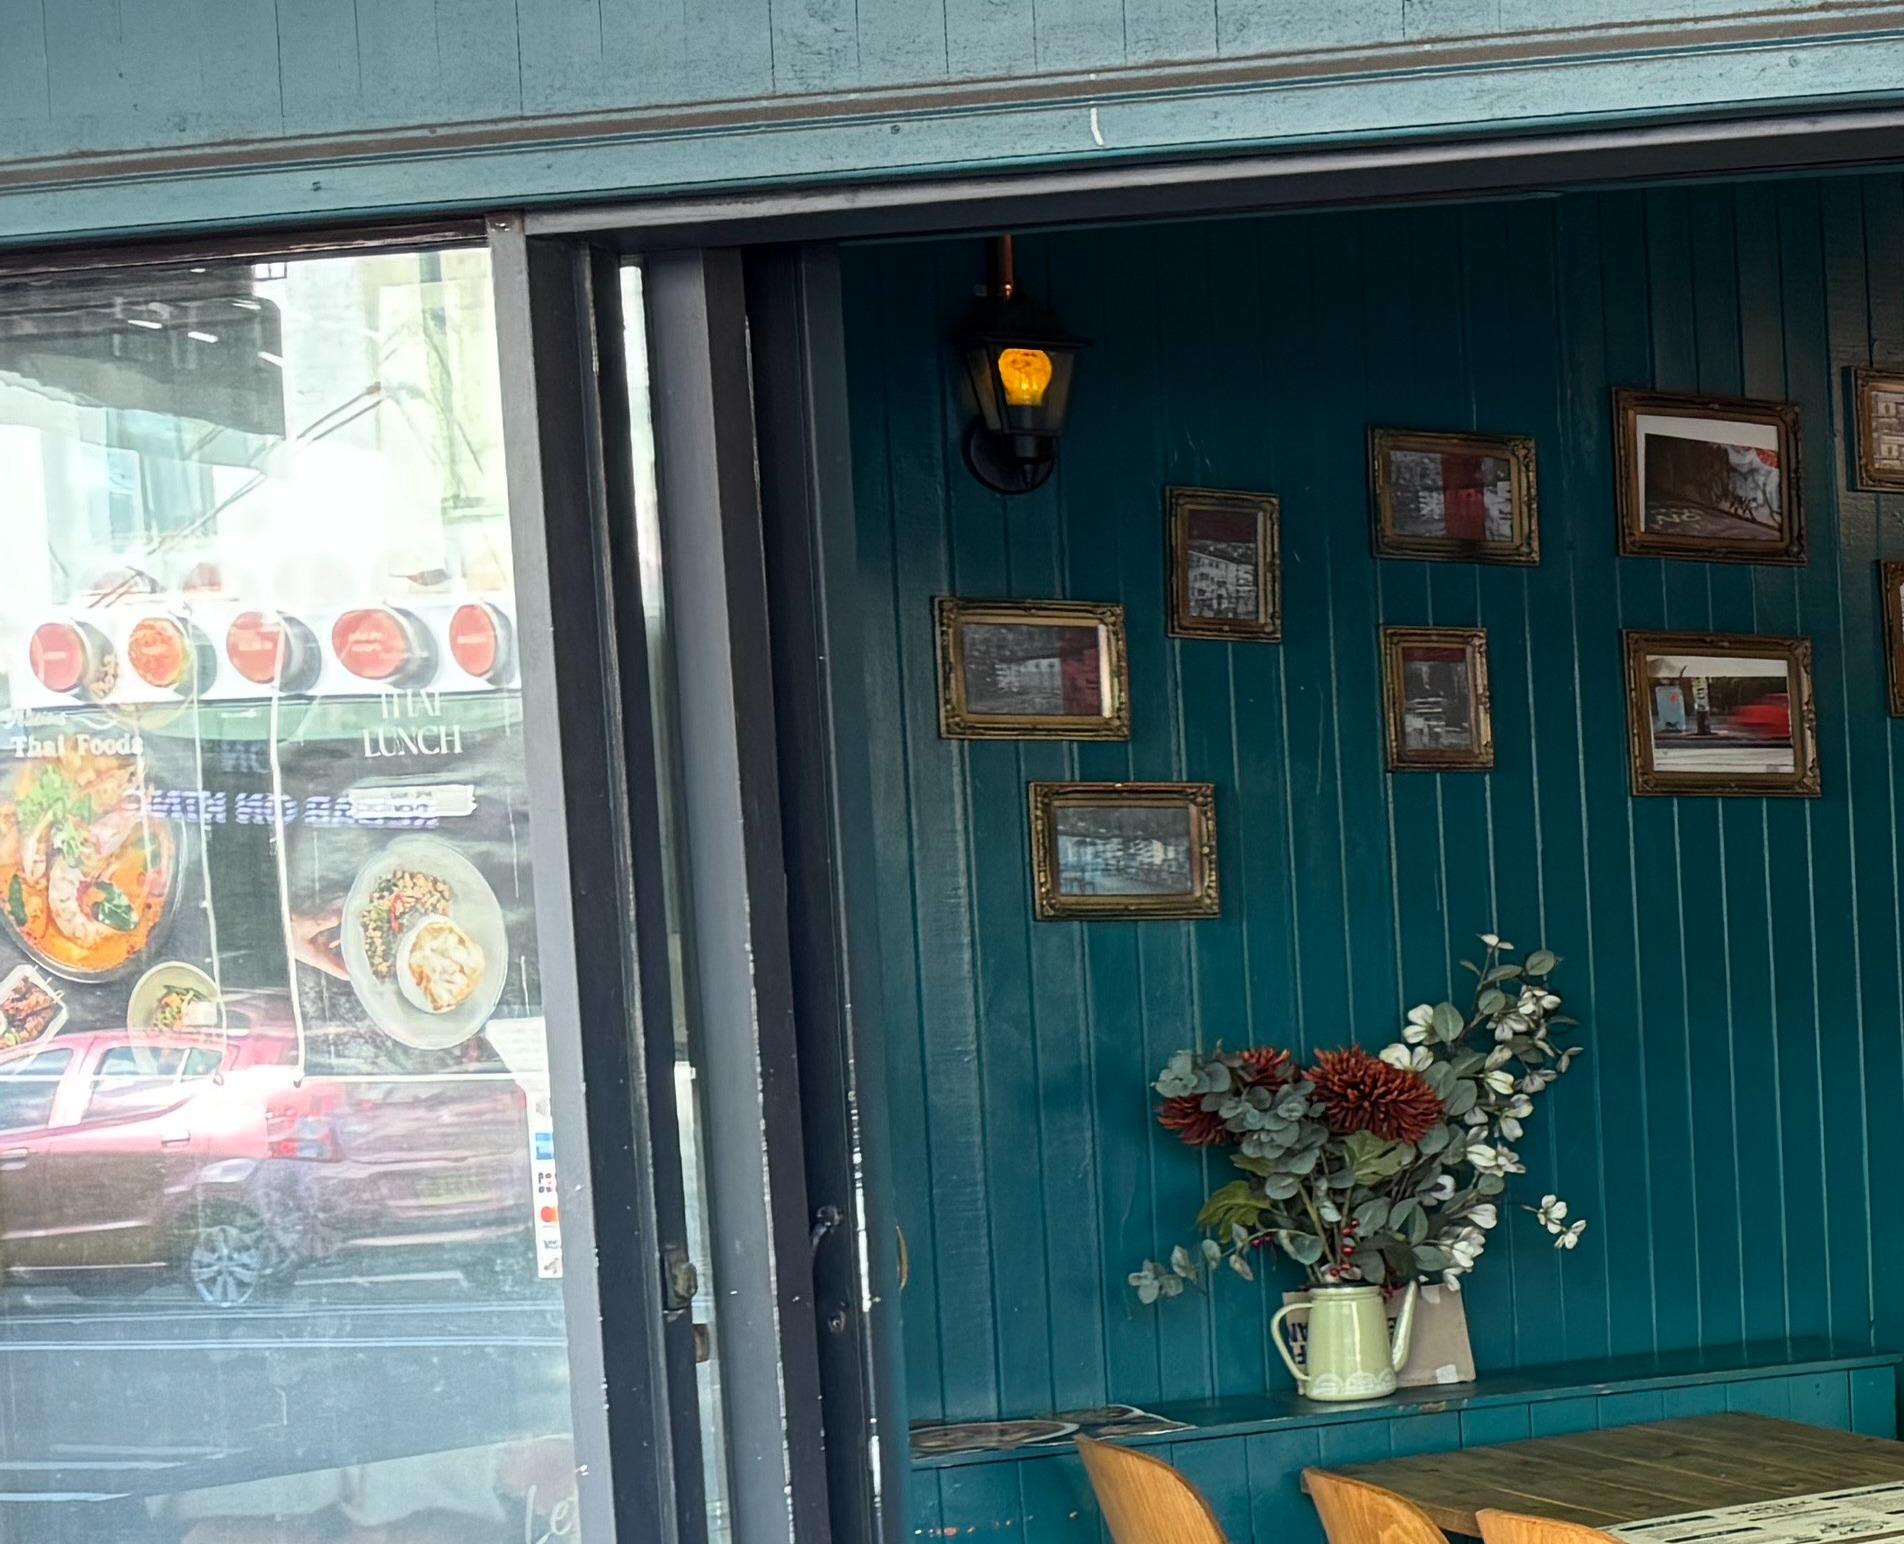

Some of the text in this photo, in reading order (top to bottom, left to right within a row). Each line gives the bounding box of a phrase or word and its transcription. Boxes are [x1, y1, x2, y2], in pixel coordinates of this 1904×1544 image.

[10, 732, 144, 759] Thai Foods
[363, 724, 463, 759] LUNCH
